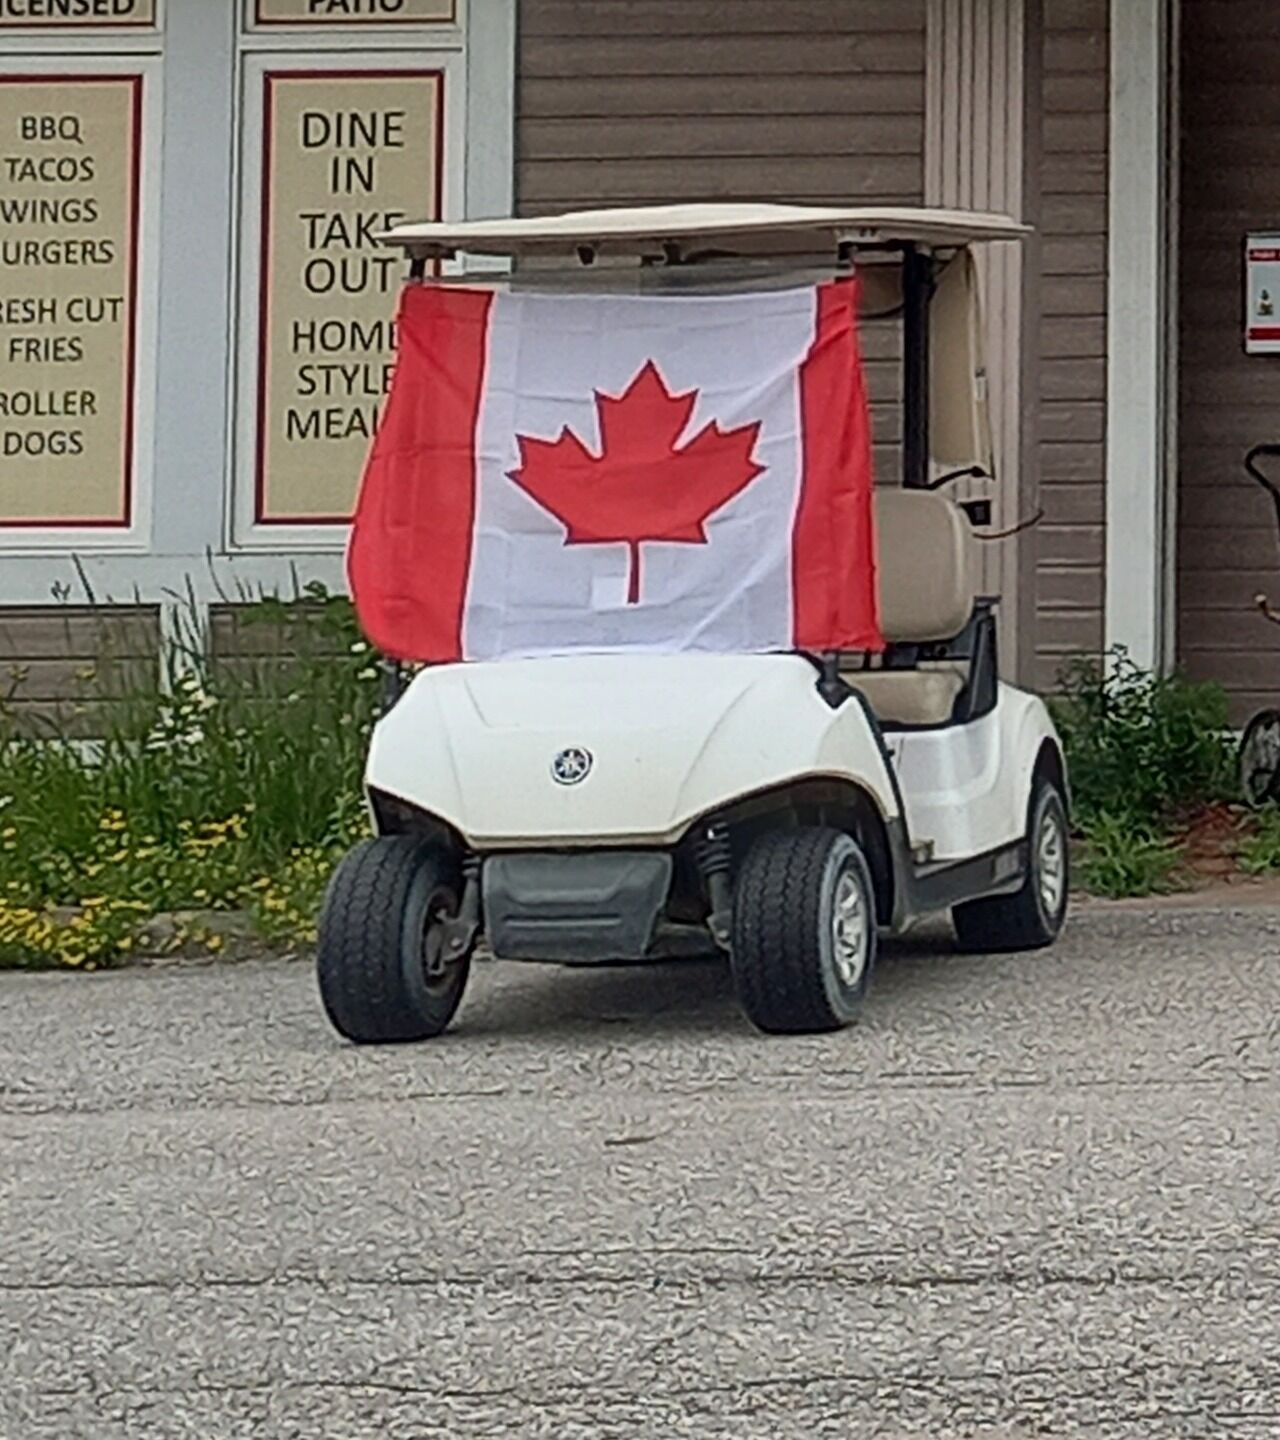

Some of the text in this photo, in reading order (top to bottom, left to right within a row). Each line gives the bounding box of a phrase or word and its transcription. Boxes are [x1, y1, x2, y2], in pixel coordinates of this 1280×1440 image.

[21, 115, 84, 145] BBQ
[302, 111, 406, 148] DINE
[5, 156, 95, 183] TACOS
[331, 156, 374, 193] IN
[0, 198, 99, 224] WINGS
[2, 239, 115, 266] URGERS
[304, 257, 399, 294] OUT
[0, 296, 124, 324] ESH CUT
[8, 336, 84, 362] FRIES
[3, 430, 84, 456] DOGS
